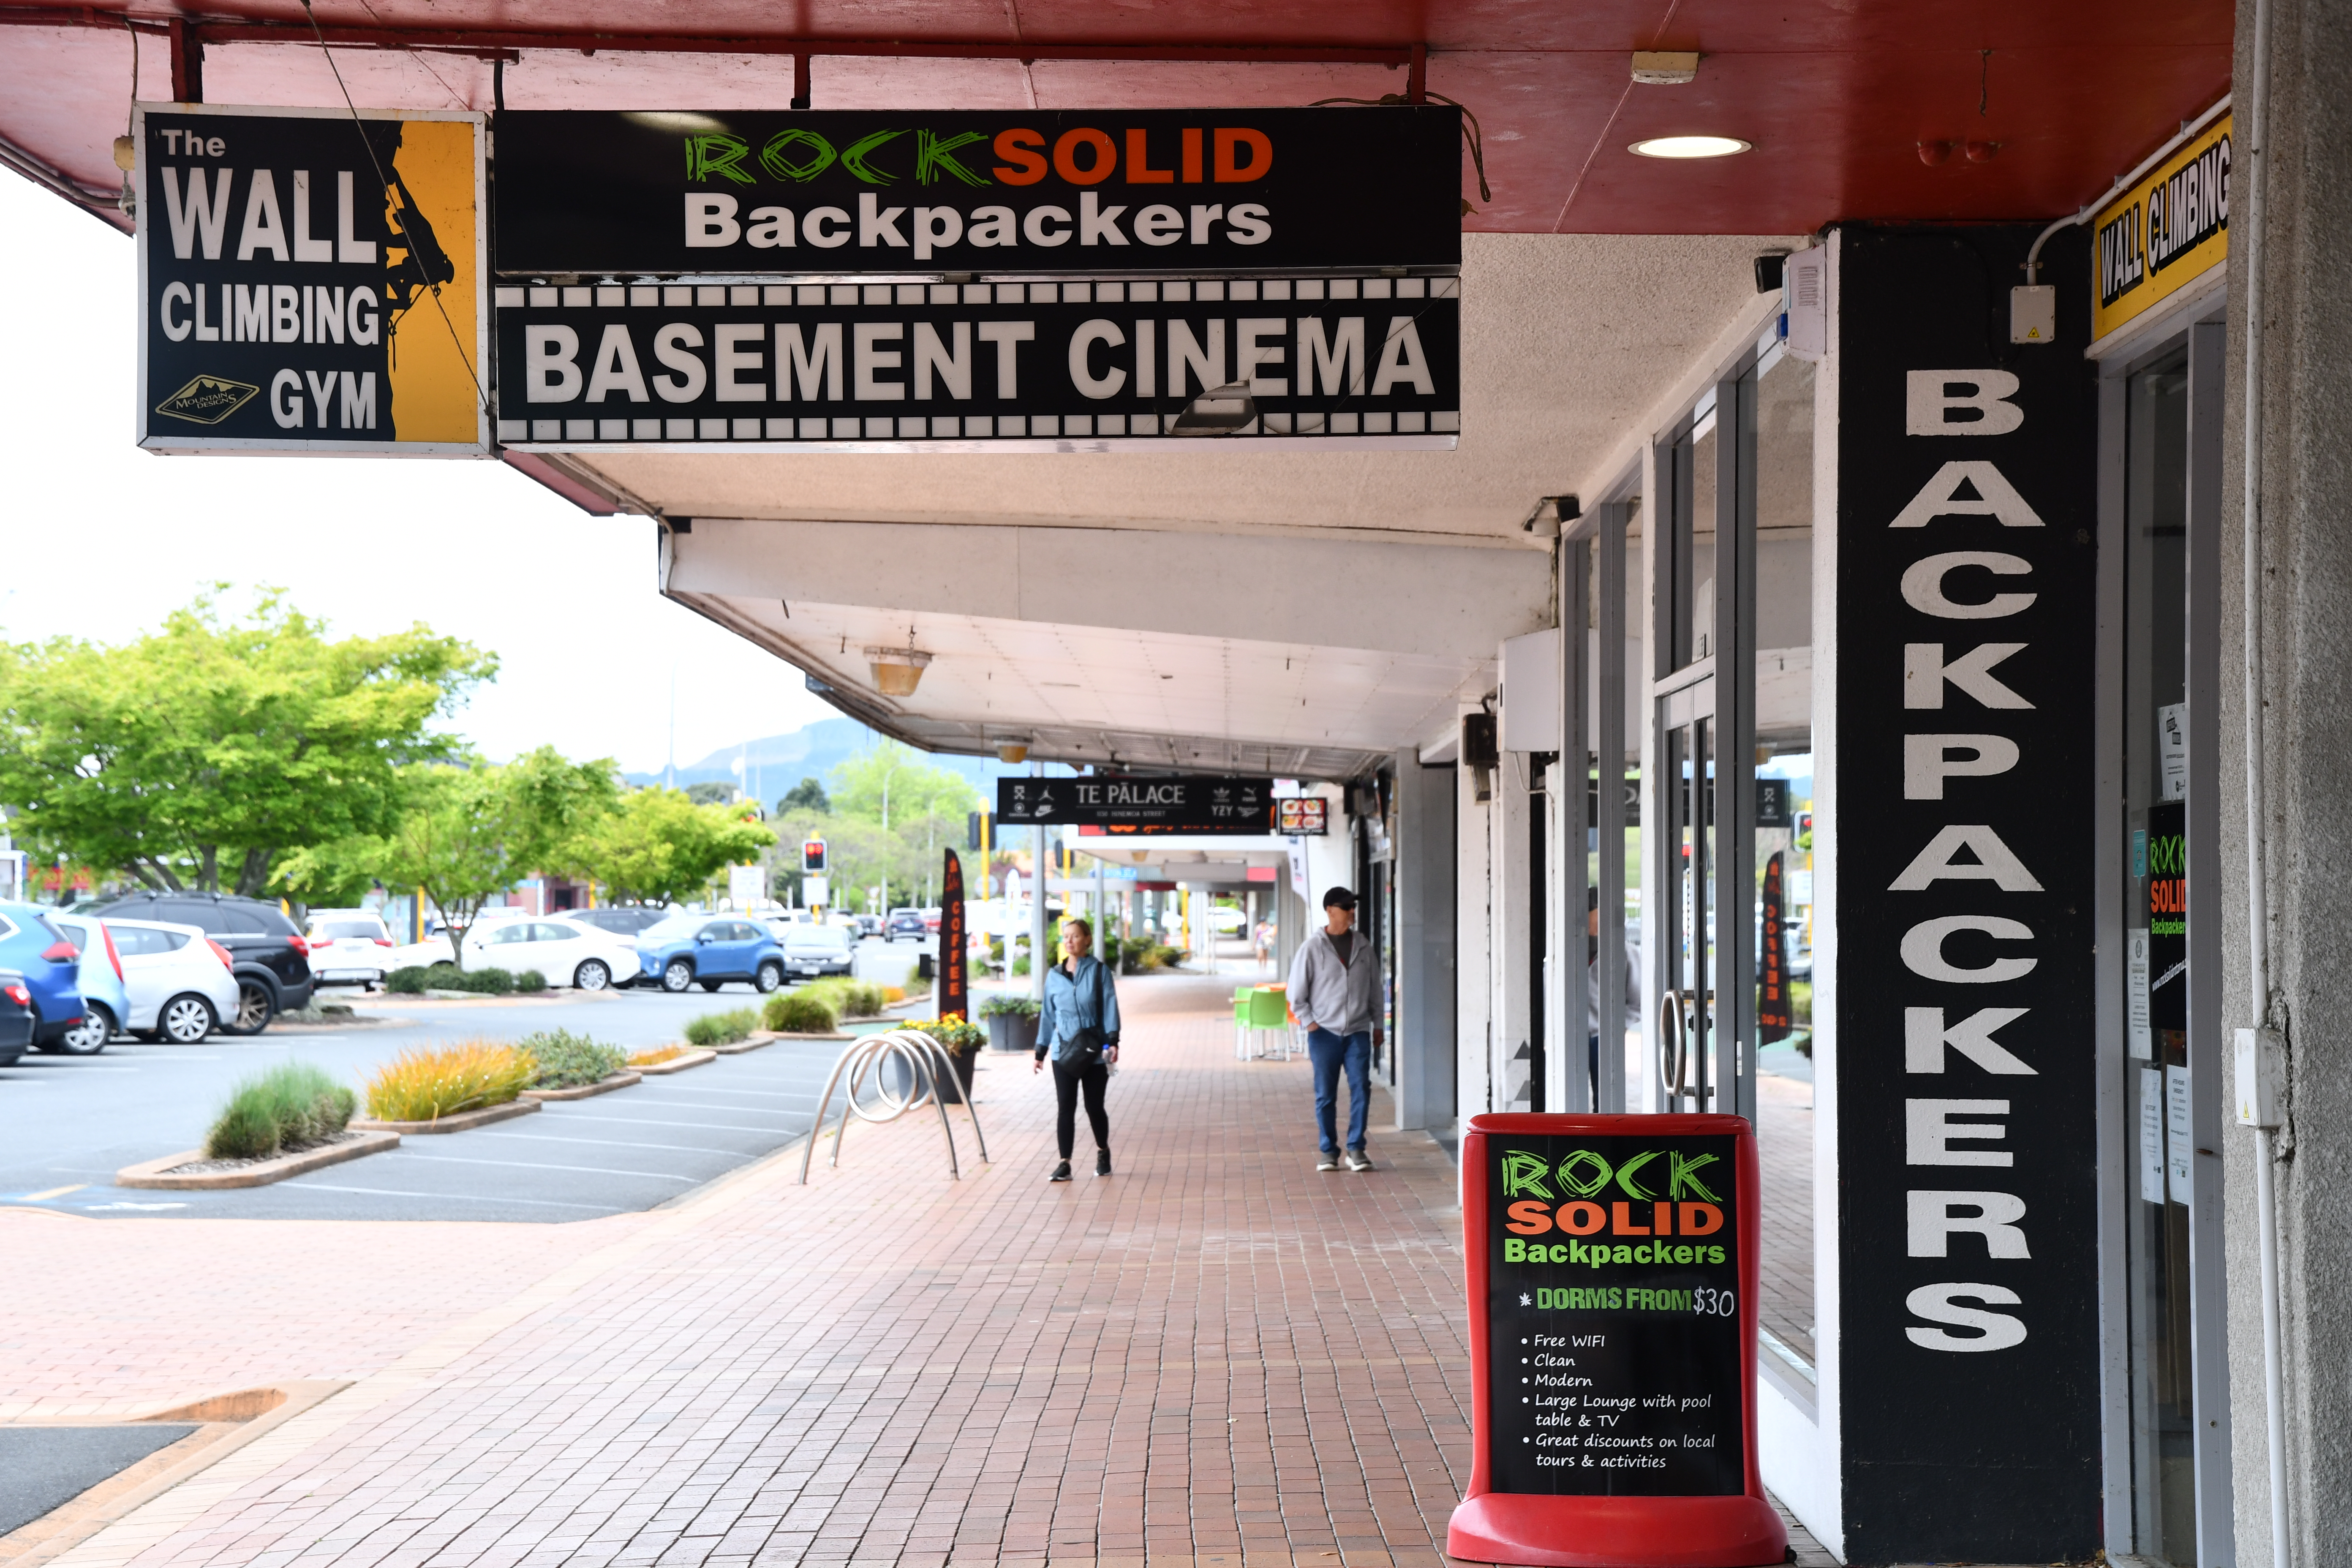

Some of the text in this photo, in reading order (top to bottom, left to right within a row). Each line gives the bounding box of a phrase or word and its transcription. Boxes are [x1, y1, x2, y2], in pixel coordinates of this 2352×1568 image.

[161, 130, 225, 157] The
[684, 128, 1272, 188] ROCK SOLID
[161, 167, 377, 263] WALL
[685, 192, 1271, 259] Backpackers
[2101, 139, 2230, 299] WALL CLIMBING
[161, 281, 378, 346] CLIMBING
[525, 316, 1435, 403] BASEMENT CINEMA
[176, 392, 227, 409] MOUNTAIN
[197, 394, 237, 409] DESIGNS
[271, 369, 376, 429] GYM
[1076, 782, 1186, 804] TE PĀLACE
[1212, 805, 1233, 816] YZY
[1887, 369, 2046, 1352] BACKPACKERS
[2150, 834, 2186, 875] ROCK
[2151, 917, 2186, 938] Backpacker
[949, 900, 961, 996] COFFEE
[1502, 1150, 1723, 1203] ROCK
[1505, 1200, 1723, 1235] SOLID
[1505, 1239, 1725, 1268] Backpackers
[1537, 1286, 1734, 1316] DORMS FROM $30
[1535, 1334, 1604, 1347] Free WIFI
[1535, 1353, 1576, 1366] Clean
[1535, 1373, 1592, 1386] Modern
[1535, 1394, 1711, 1411] Large Lounge with pool
[1535, 1412, 1620, 1426] table & TV
[1536, 1433, 1715, 1447] Great discounts on local
[1536, 1454, 1666, 1467] tours & activities
